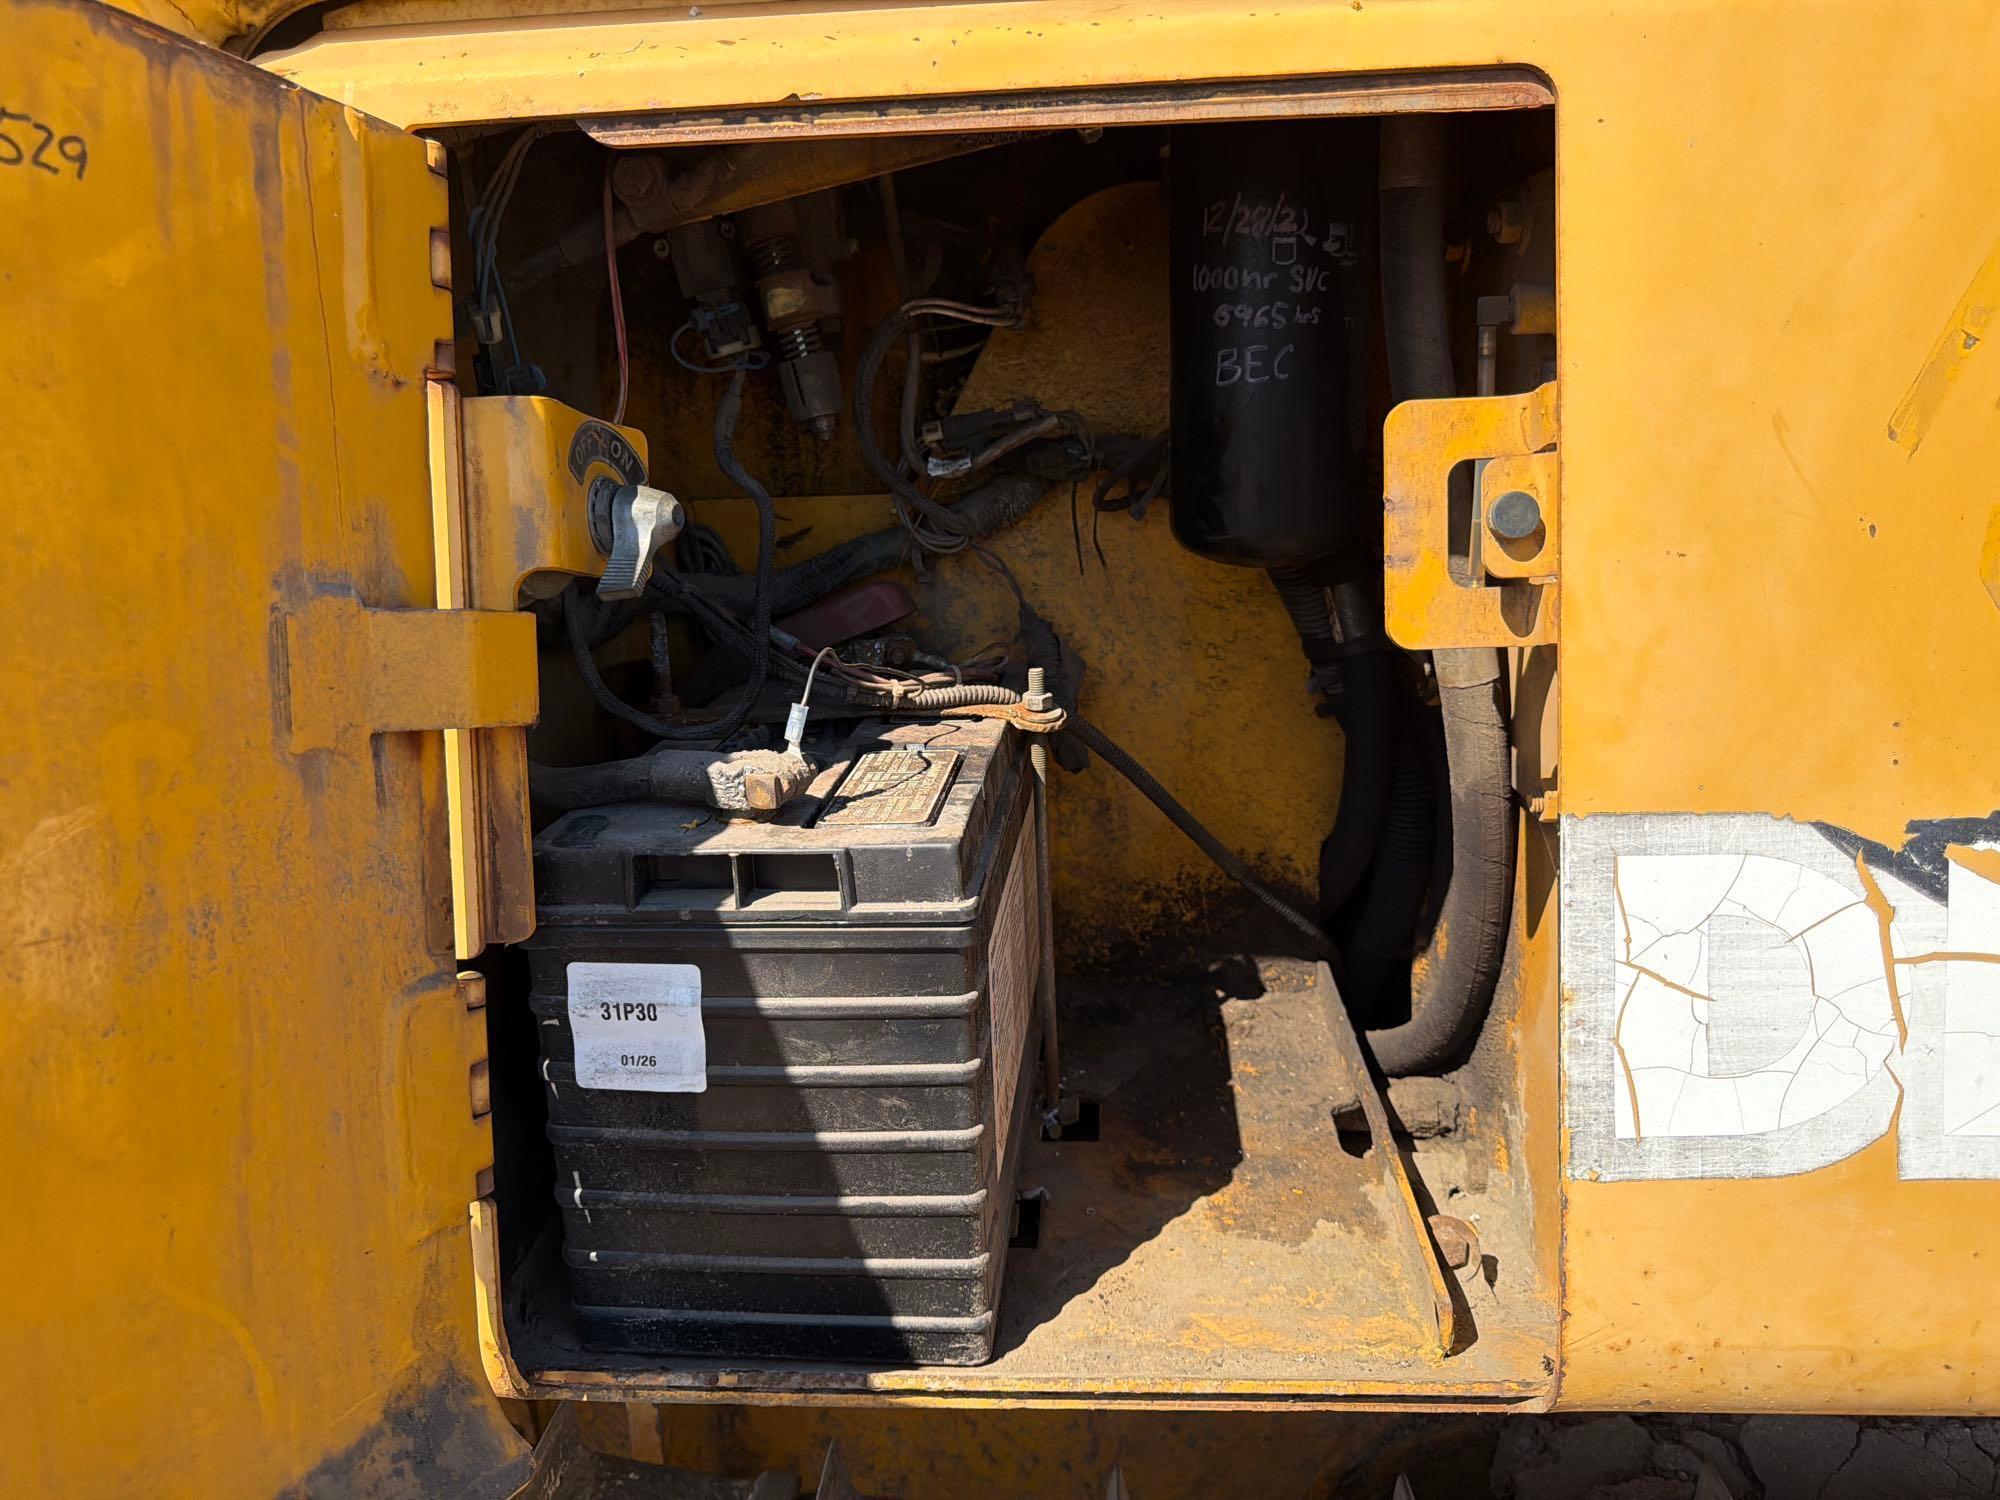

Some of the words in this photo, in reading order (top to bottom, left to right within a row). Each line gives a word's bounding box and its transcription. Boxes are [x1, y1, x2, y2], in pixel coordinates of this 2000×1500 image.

[1289, 264, 1331, 293] SVC
[1213, 301, 1290, 330] 6965
[1216, 344, 1294, 387] BEC
[611, 441, 634, 472] ON
[601, 1001, 658, 1022] 31P30
[621, 1054, 657, 1067] 01/26
